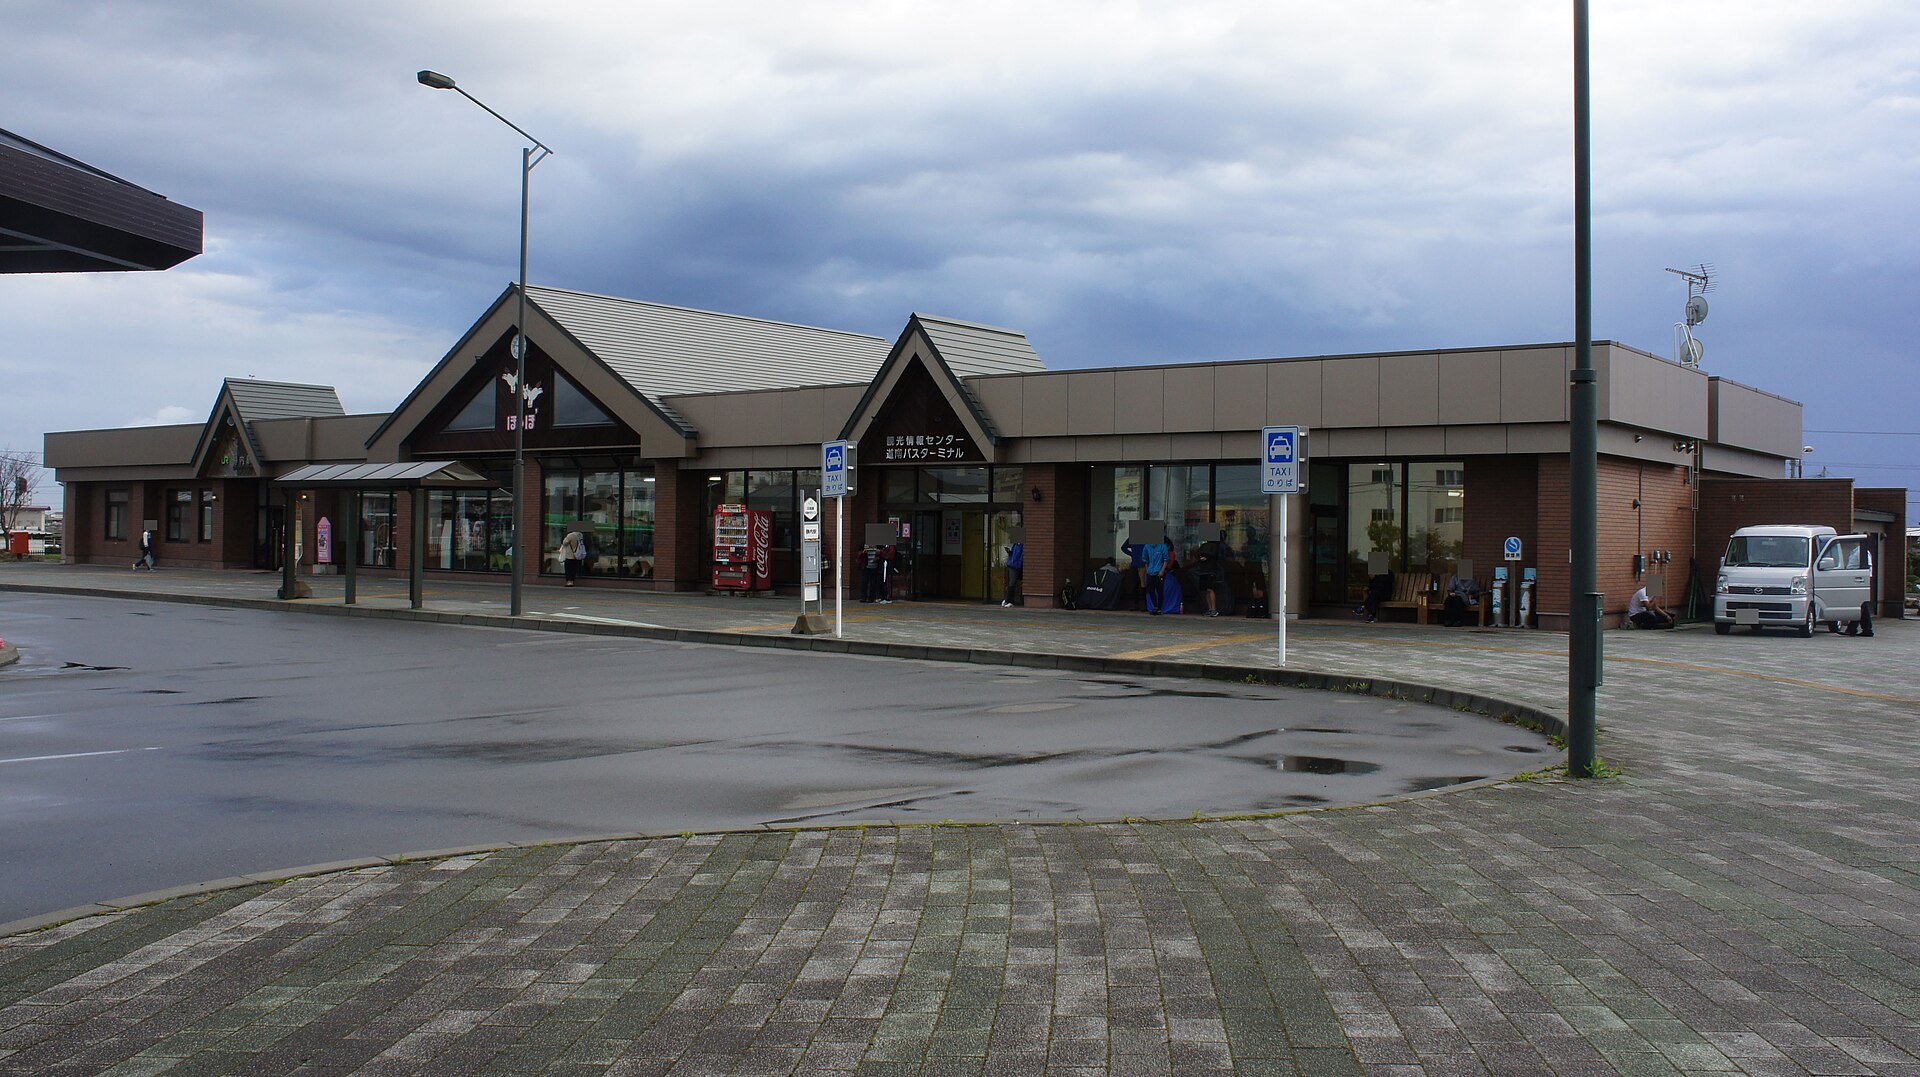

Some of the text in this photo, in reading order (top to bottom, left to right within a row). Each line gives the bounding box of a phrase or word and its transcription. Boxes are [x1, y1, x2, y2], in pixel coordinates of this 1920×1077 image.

[886, 435, 964, 446] 観光情報センター
[886, 448, 964, 459] 道南バスターミナル
[221, 455, 229, 465] JR
[1270, 467, 1291, 476] TAXI
[827, 474, 842, 482] TAXI
[1267, 479, 1293, 487] のりば
